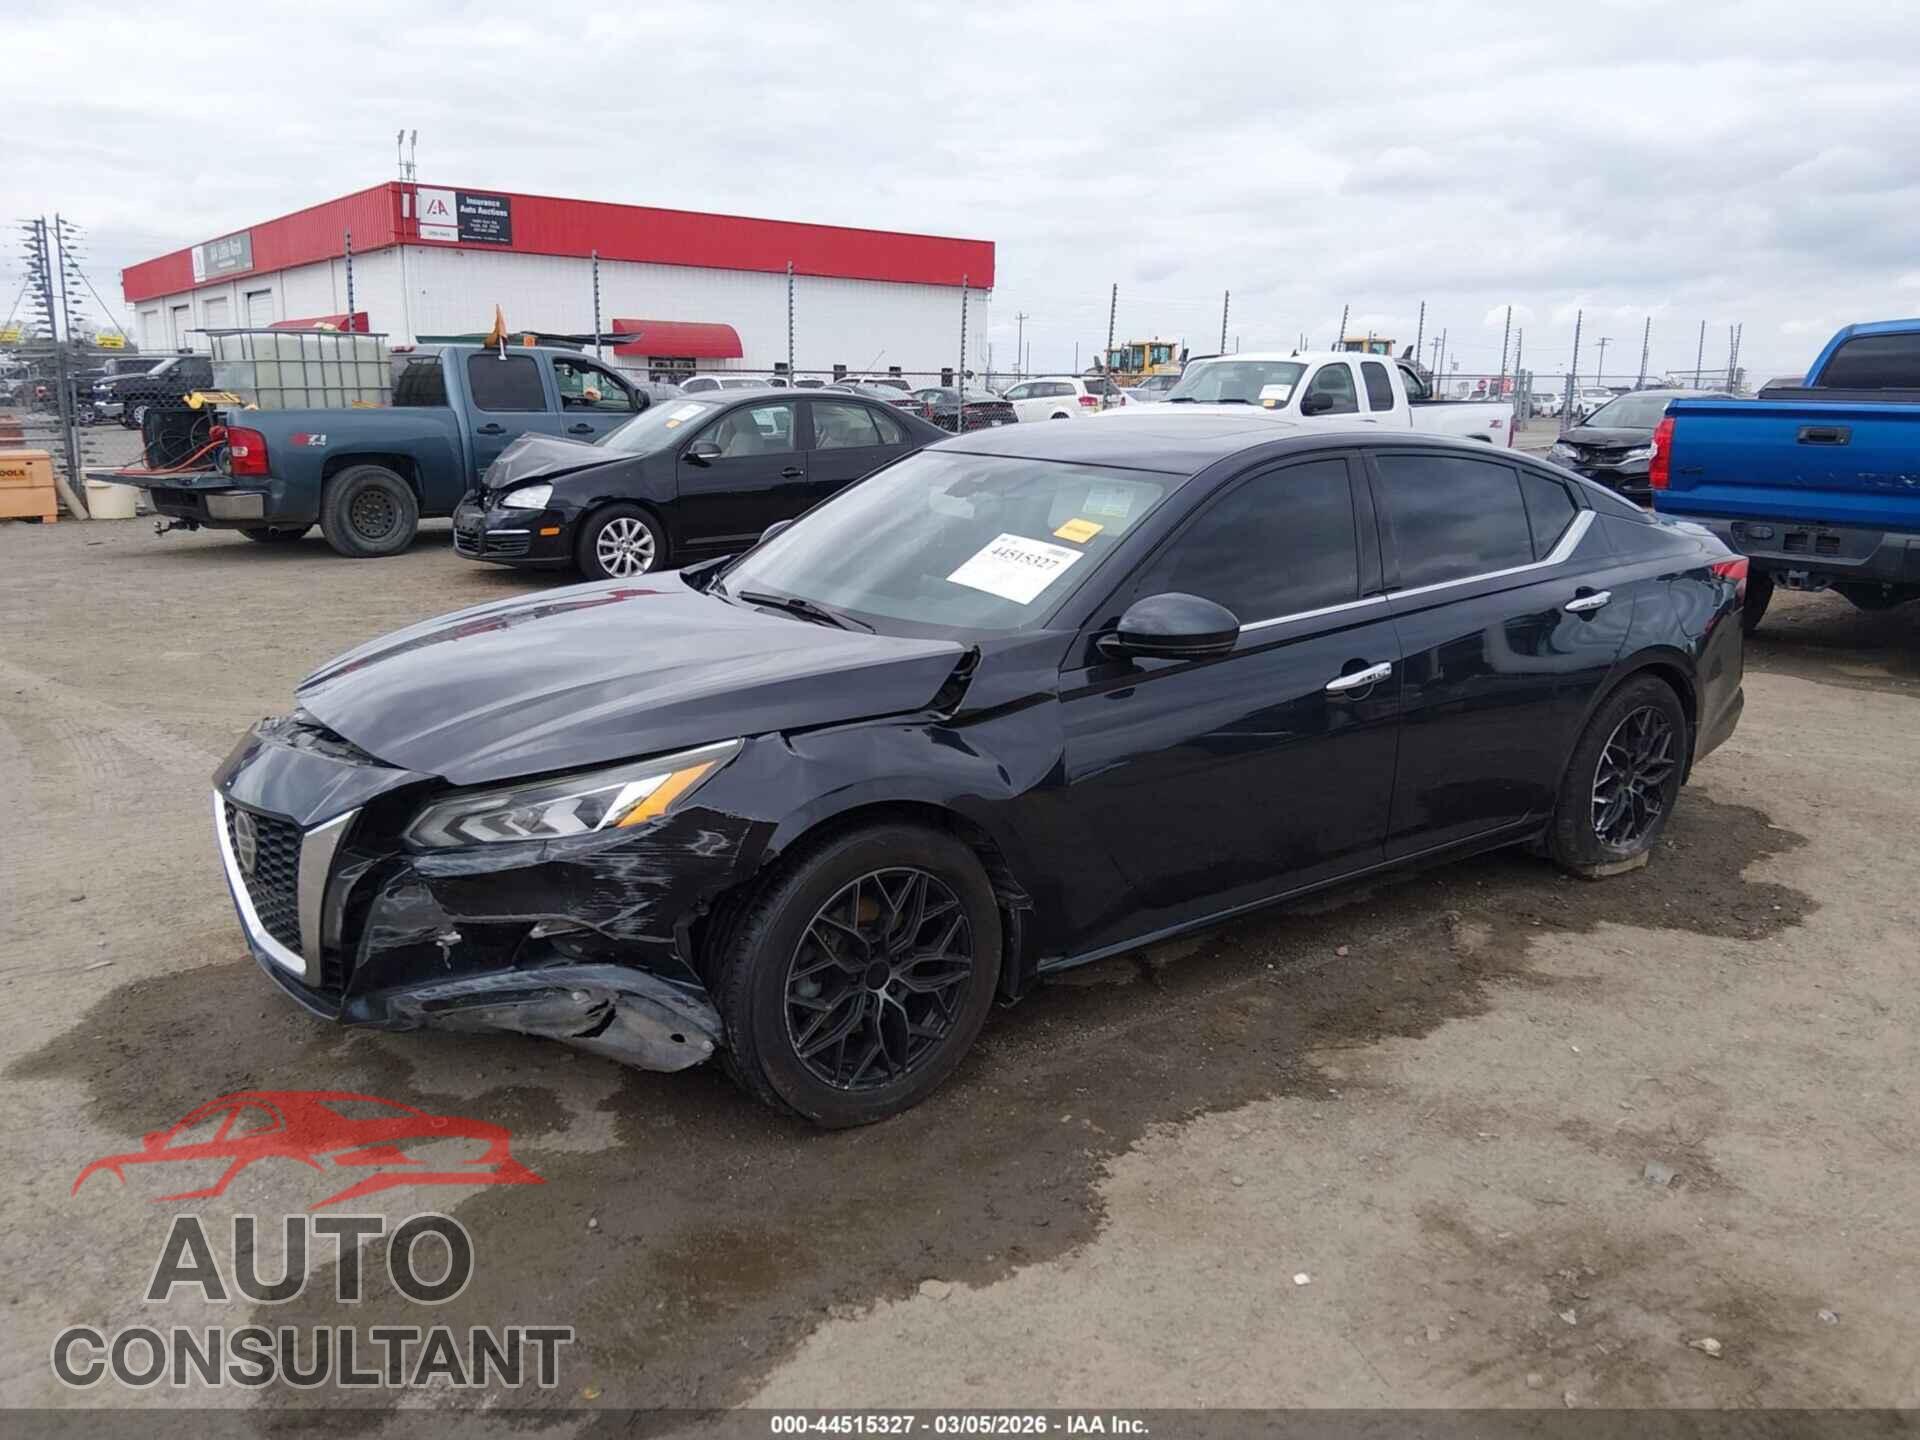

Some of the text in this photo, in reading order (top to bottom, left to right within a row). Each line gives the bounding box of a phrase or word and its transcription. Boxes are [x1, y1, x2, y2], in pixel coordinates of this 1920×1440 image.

[466, 196, 500, 207] Insurance
[460, 205, 508, 217] Auto Auctions
[991, 546, 1060, 571] 44515327
